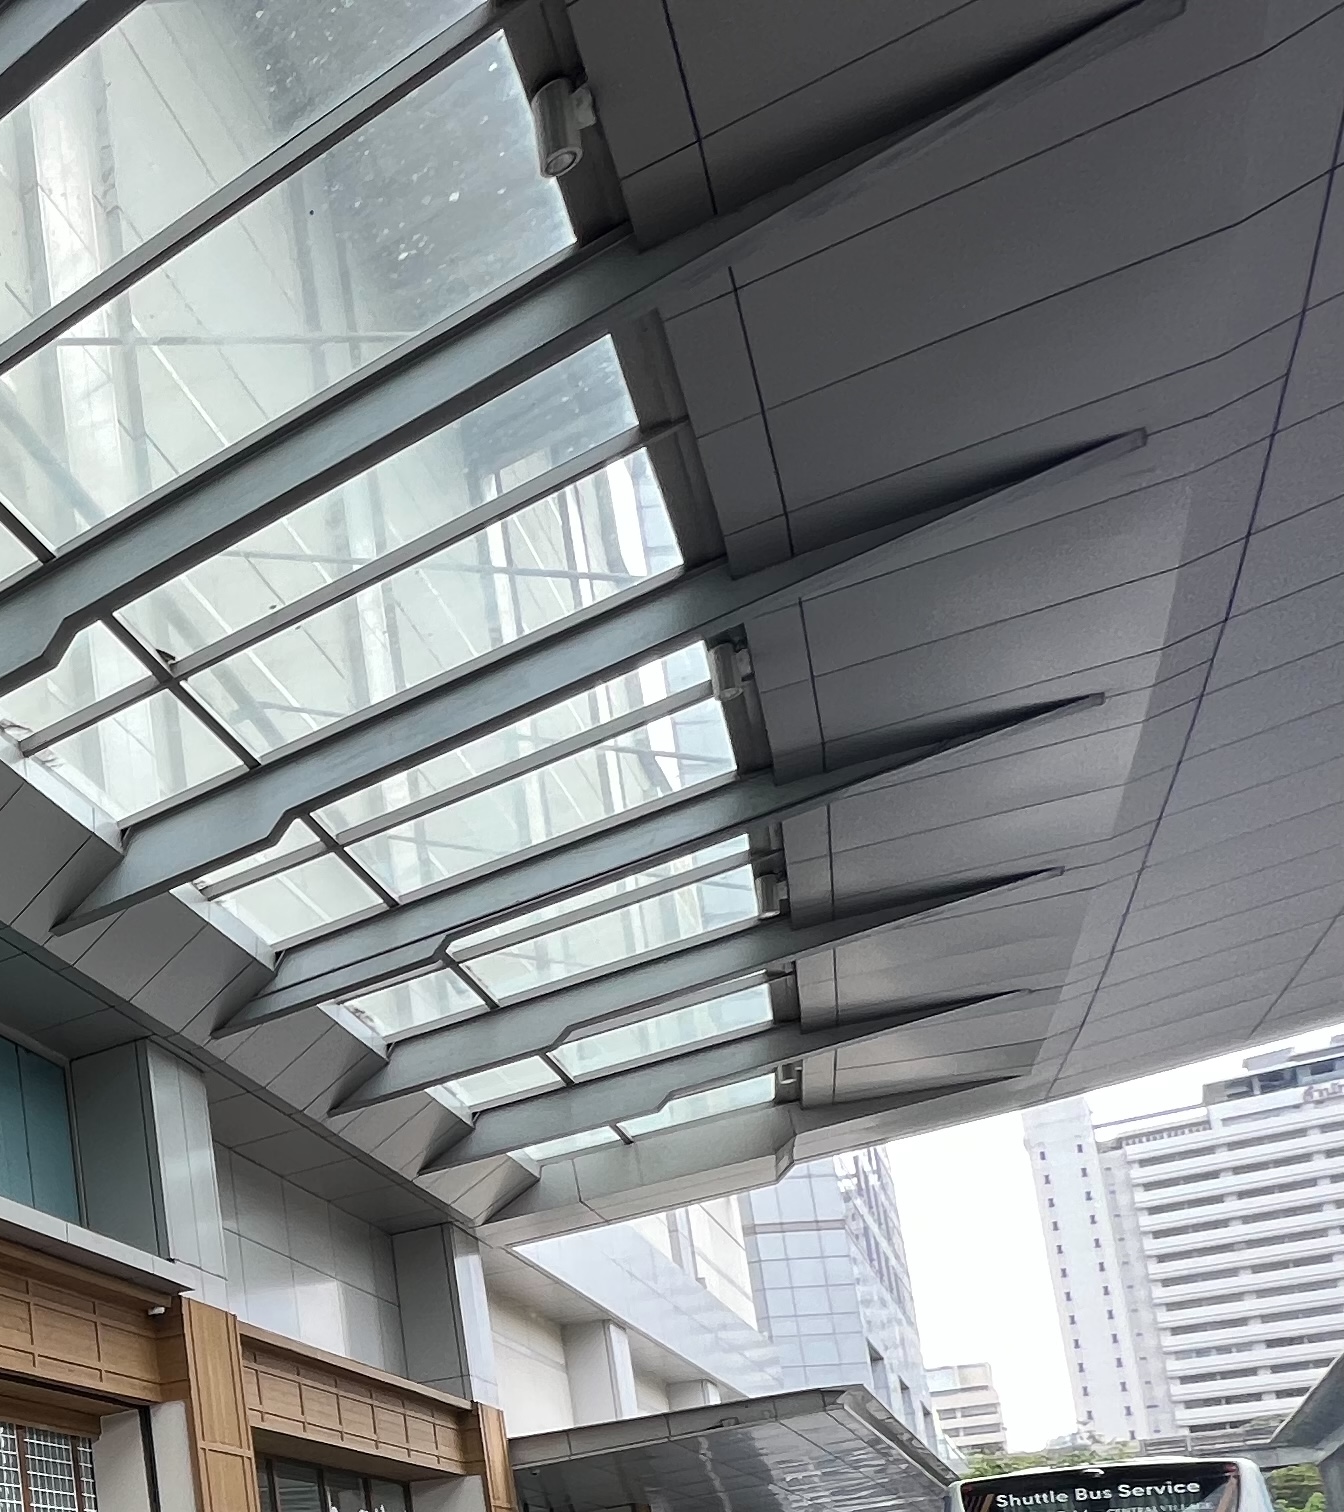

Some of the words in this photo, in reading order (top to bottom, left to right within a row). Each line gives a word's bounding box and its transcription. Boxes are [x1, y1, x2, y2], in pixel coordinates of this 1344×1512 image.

[996, 1489, 1069, 1508] Shuttle
[1075, 1486, 1112, 1502] Bus
[1117, 1480, 1201, 1499] Service
